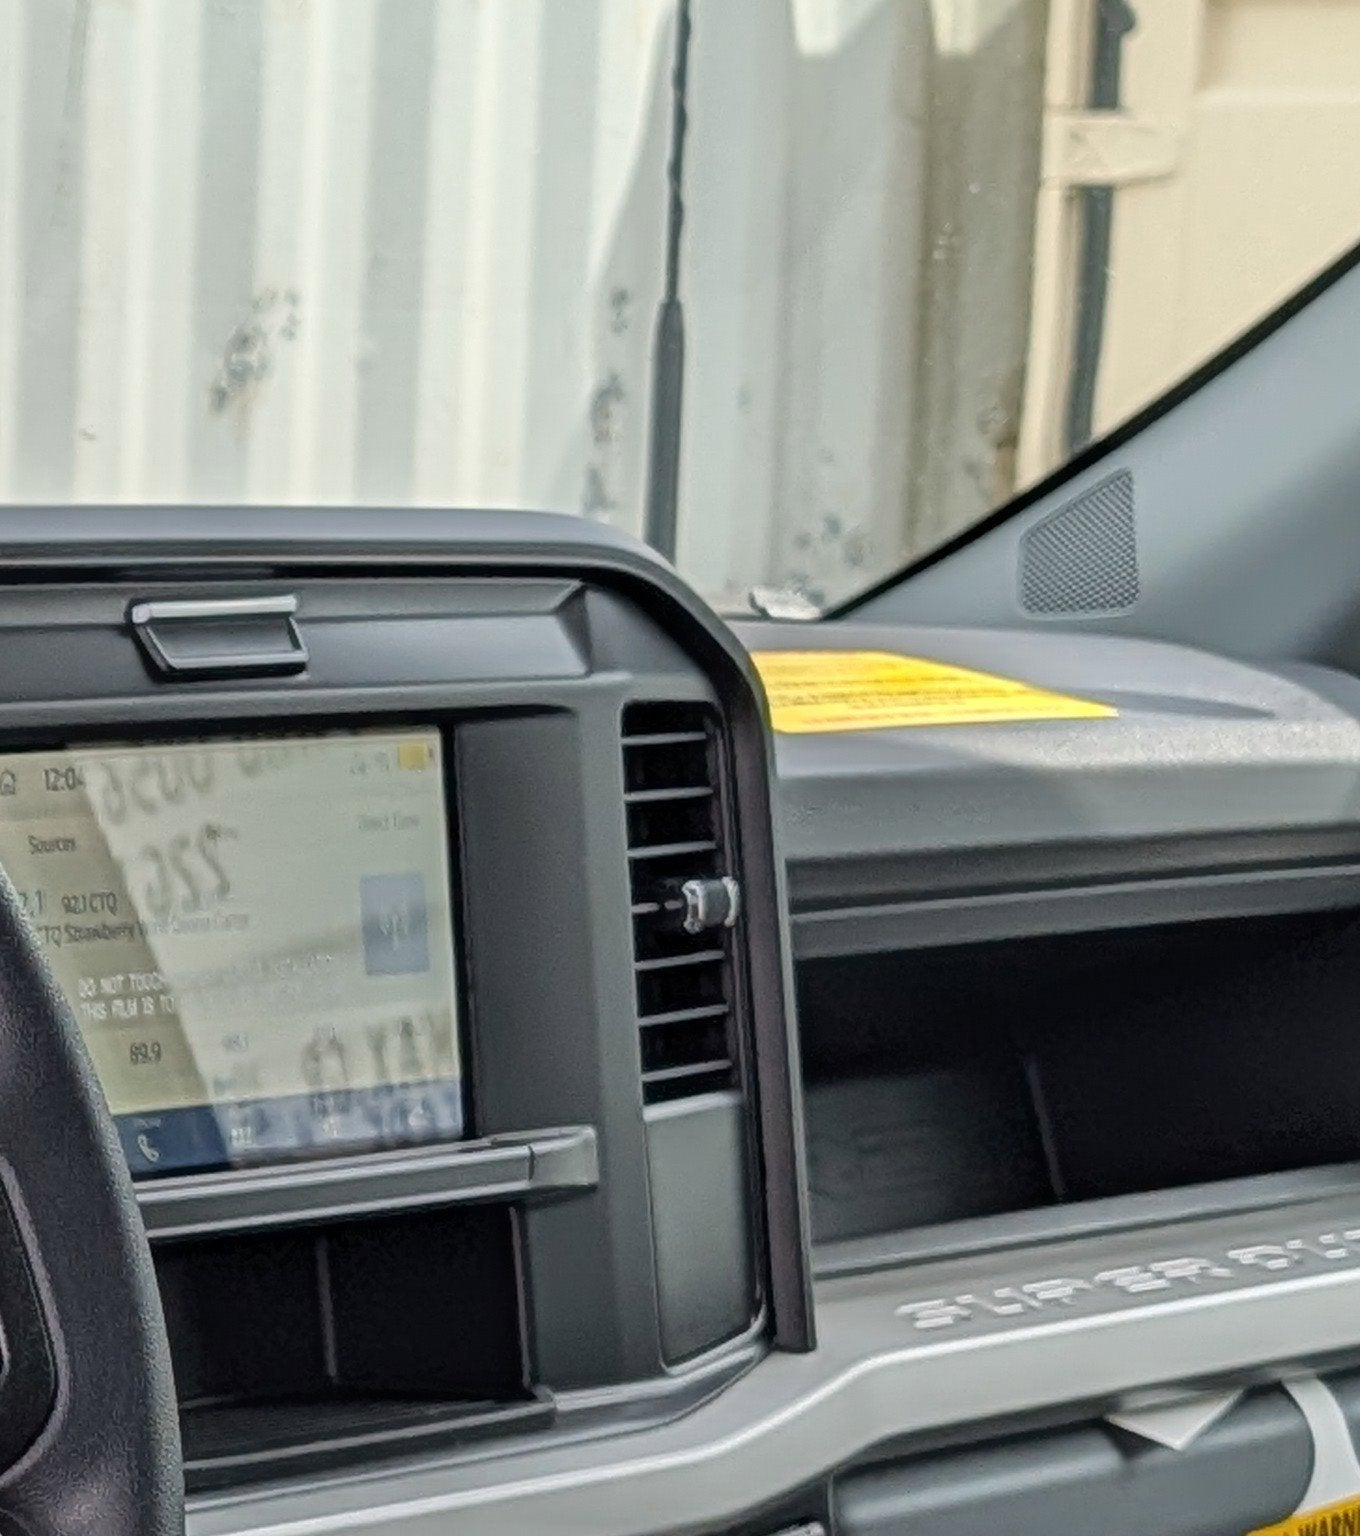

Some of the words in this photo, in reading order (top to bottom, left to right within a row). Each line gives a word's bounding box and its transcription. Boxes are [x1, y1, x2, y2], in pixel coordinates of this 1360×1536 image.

[42, 765, 84, 793] 12:0
[28, 834, 76, 856] Sources
[89, 891, 119, 917] CTQ
[894, 1255, 1234, 1331] SUPER
